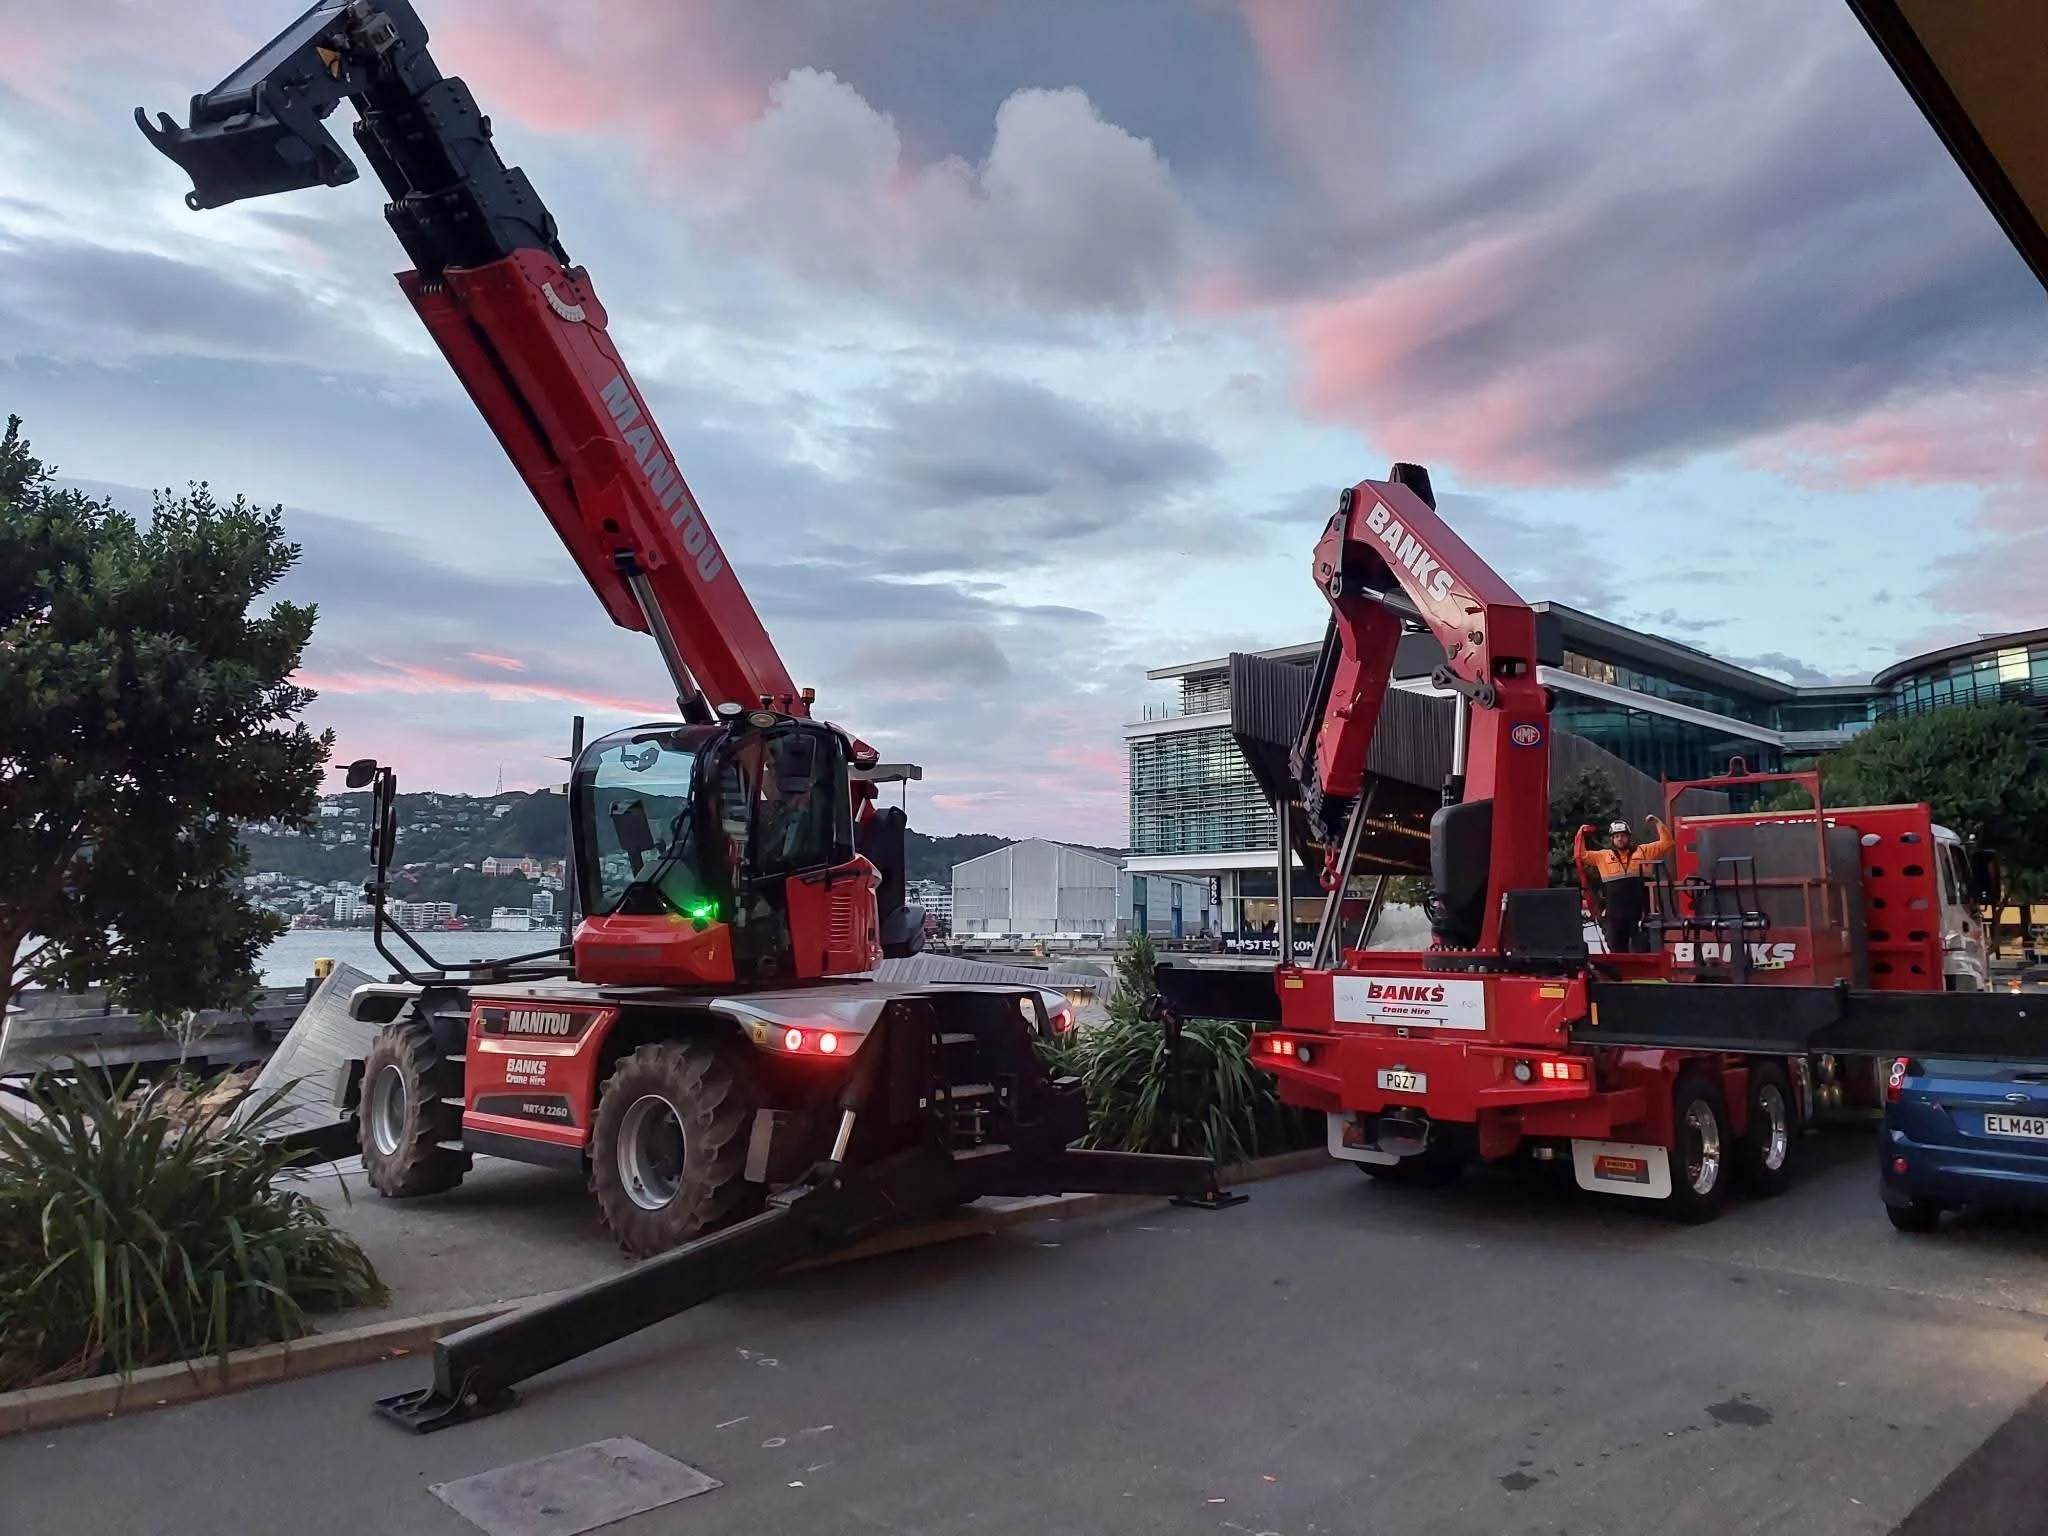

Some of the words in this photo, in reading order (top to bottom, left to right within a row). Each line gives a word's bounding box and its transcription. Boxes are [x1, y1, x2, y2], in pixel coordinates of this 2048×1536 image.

[602, 375, 723, 582] MANITOU
[1365, 501, 1455, 602] BANKS
[1210, 877, 1218, 905] KONG
[1367, 984, 1445, 1002] BANKS
[1382, 1006, 1409, 1014] Crane
[1411, 1007, 1431, 1015] Hire
[508, 1010, 571, 1036] MANITOU
[506, 1058, 547, 1075] BANKS
[529, 1075, 546, 1086] Hire
[1386, 1073, 1417, 1089] PQZ7
[547, 1106, 568, 1117] 2260
[1987, 1116, 2048, 1136] ELM40
